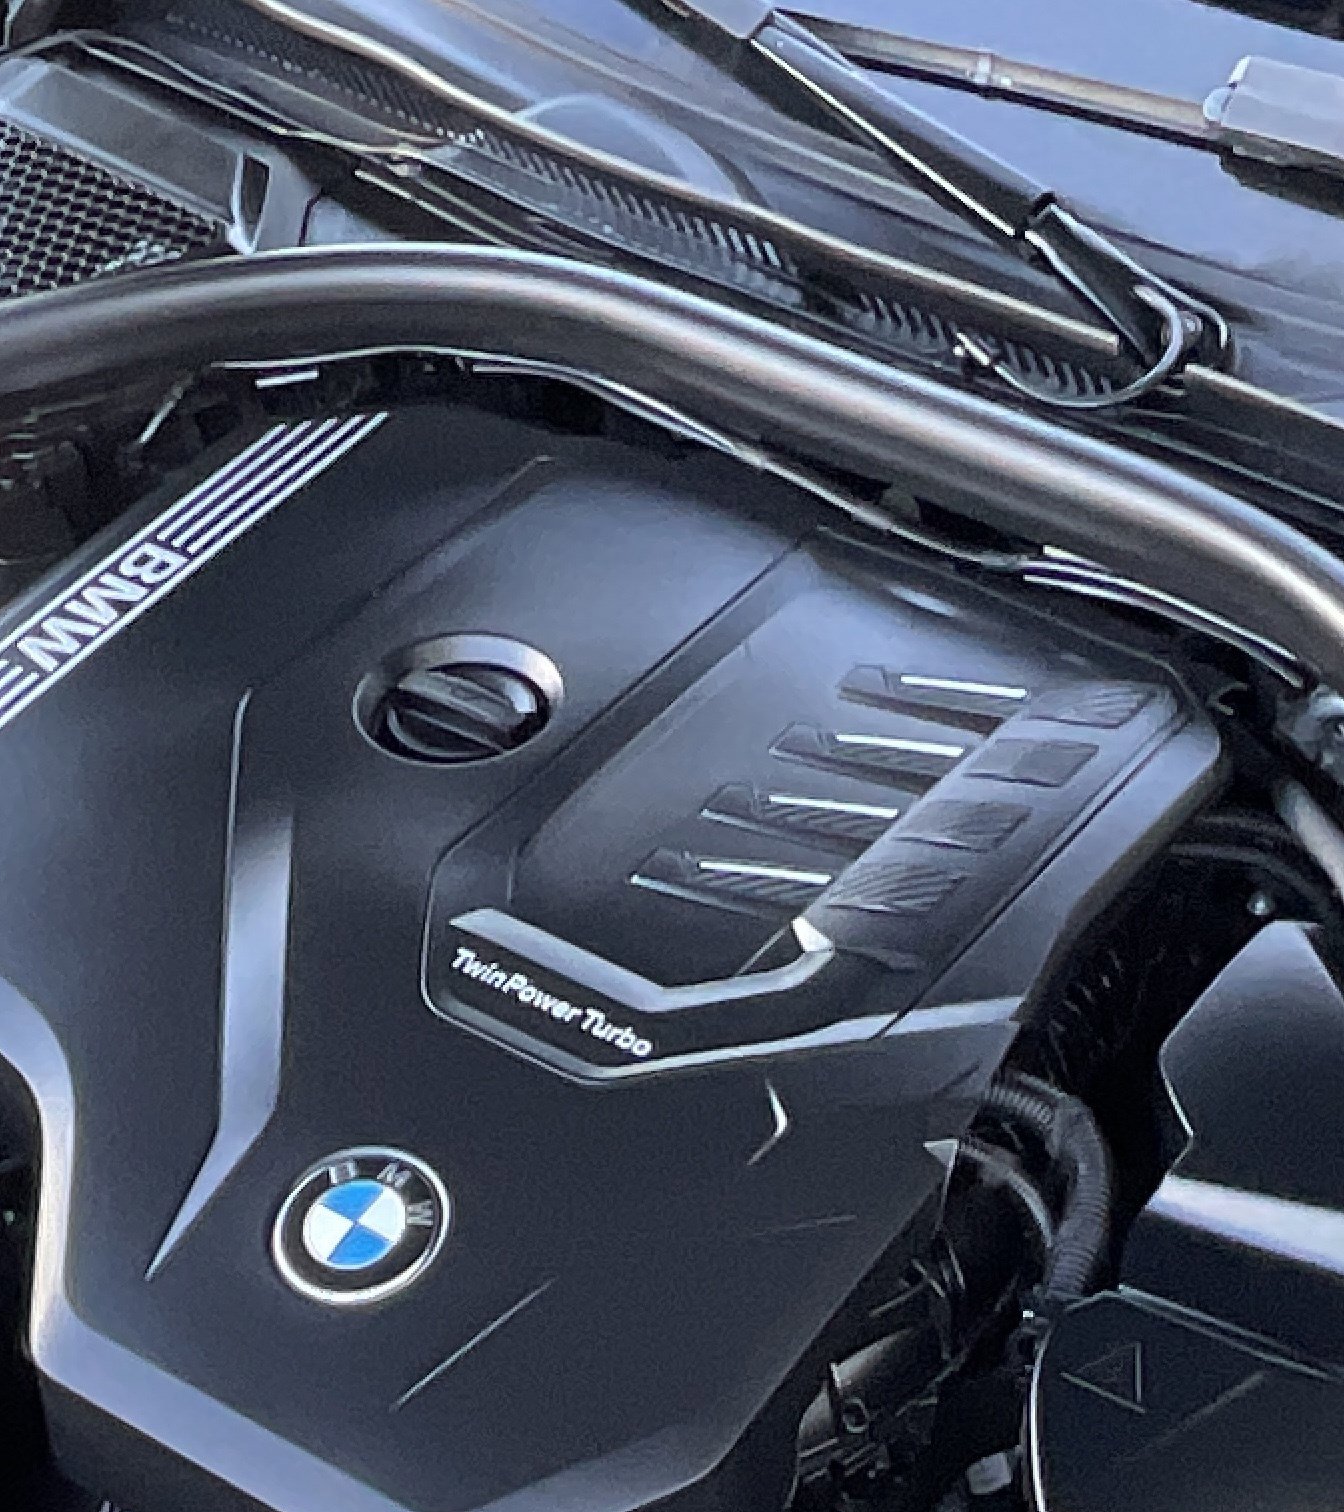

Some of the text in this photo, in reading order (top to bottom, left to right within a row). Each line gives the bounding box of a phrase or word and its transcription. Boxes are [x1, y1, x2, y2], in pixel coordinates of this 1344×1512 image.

[17, 543, 189, 671] BMW
[452, 947, 654, 1057] TwinPower Turbo
[328, 1160, 434, 1226] BMW
